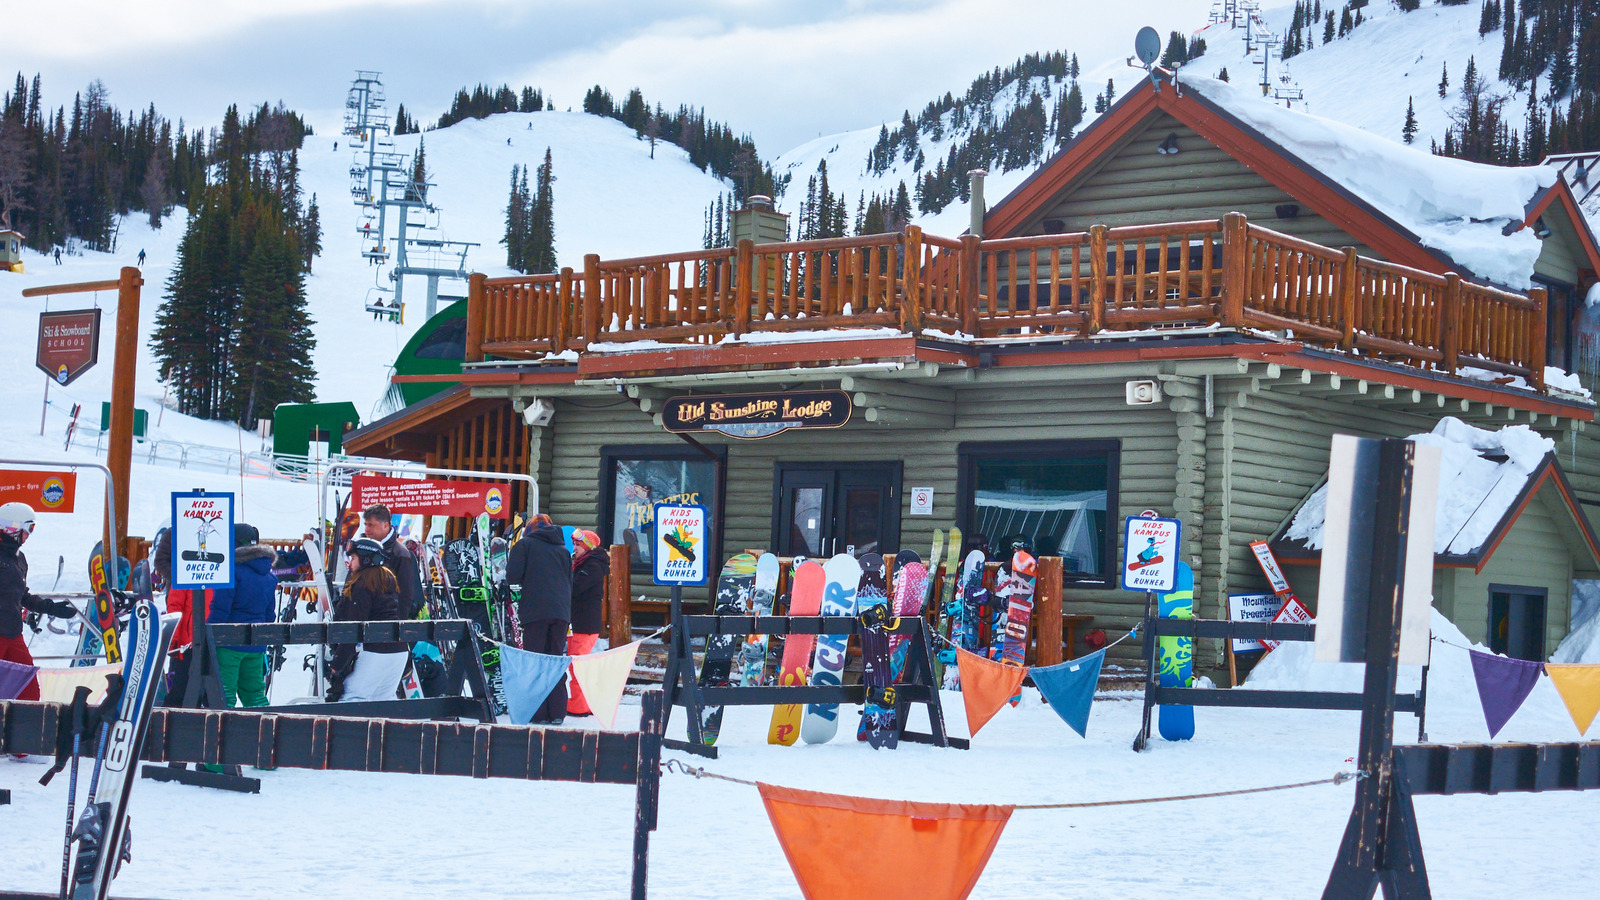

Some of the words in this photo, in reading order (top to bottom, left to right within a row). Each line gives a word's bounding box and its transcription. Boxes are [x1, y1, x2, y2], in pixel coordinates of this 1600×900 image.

[44, 326, 54, 338] Ski
[54, 325, 60, 336] &
[60, 323, 90, 336] Snowboard
[48, 338, 85, 347] SCHOOL
[678, 402, 705, 422] Old
[709, 399, 778, 420] Sunshine
[782, 398, 832, 418] Lodge
[0, 484, 15, 492] ycare
[192, 500, 214, 508] KIDS
[184, 510, 222, 518] KAMPUS
[670, 509, 691, 517] KIDS
[662, 518, 699, 527] KAMPUS
[1134, 529, 1170, 537] KAMPUS
[209, 563, 220, 571] OR
[666, 560, 694, 568] GREEN
[191, 572, 214, 580] TWICE
[663, 569, 697, 578] RUNNER
[1134, 578, 1165, 586] RUNNER
[1242, 596, 1281, 606] Mountain
[1293, 605, 1307, 621] BIG
[126, 628, 149, 700] DYNASTAR
[106, 720, 133, 772] 63
